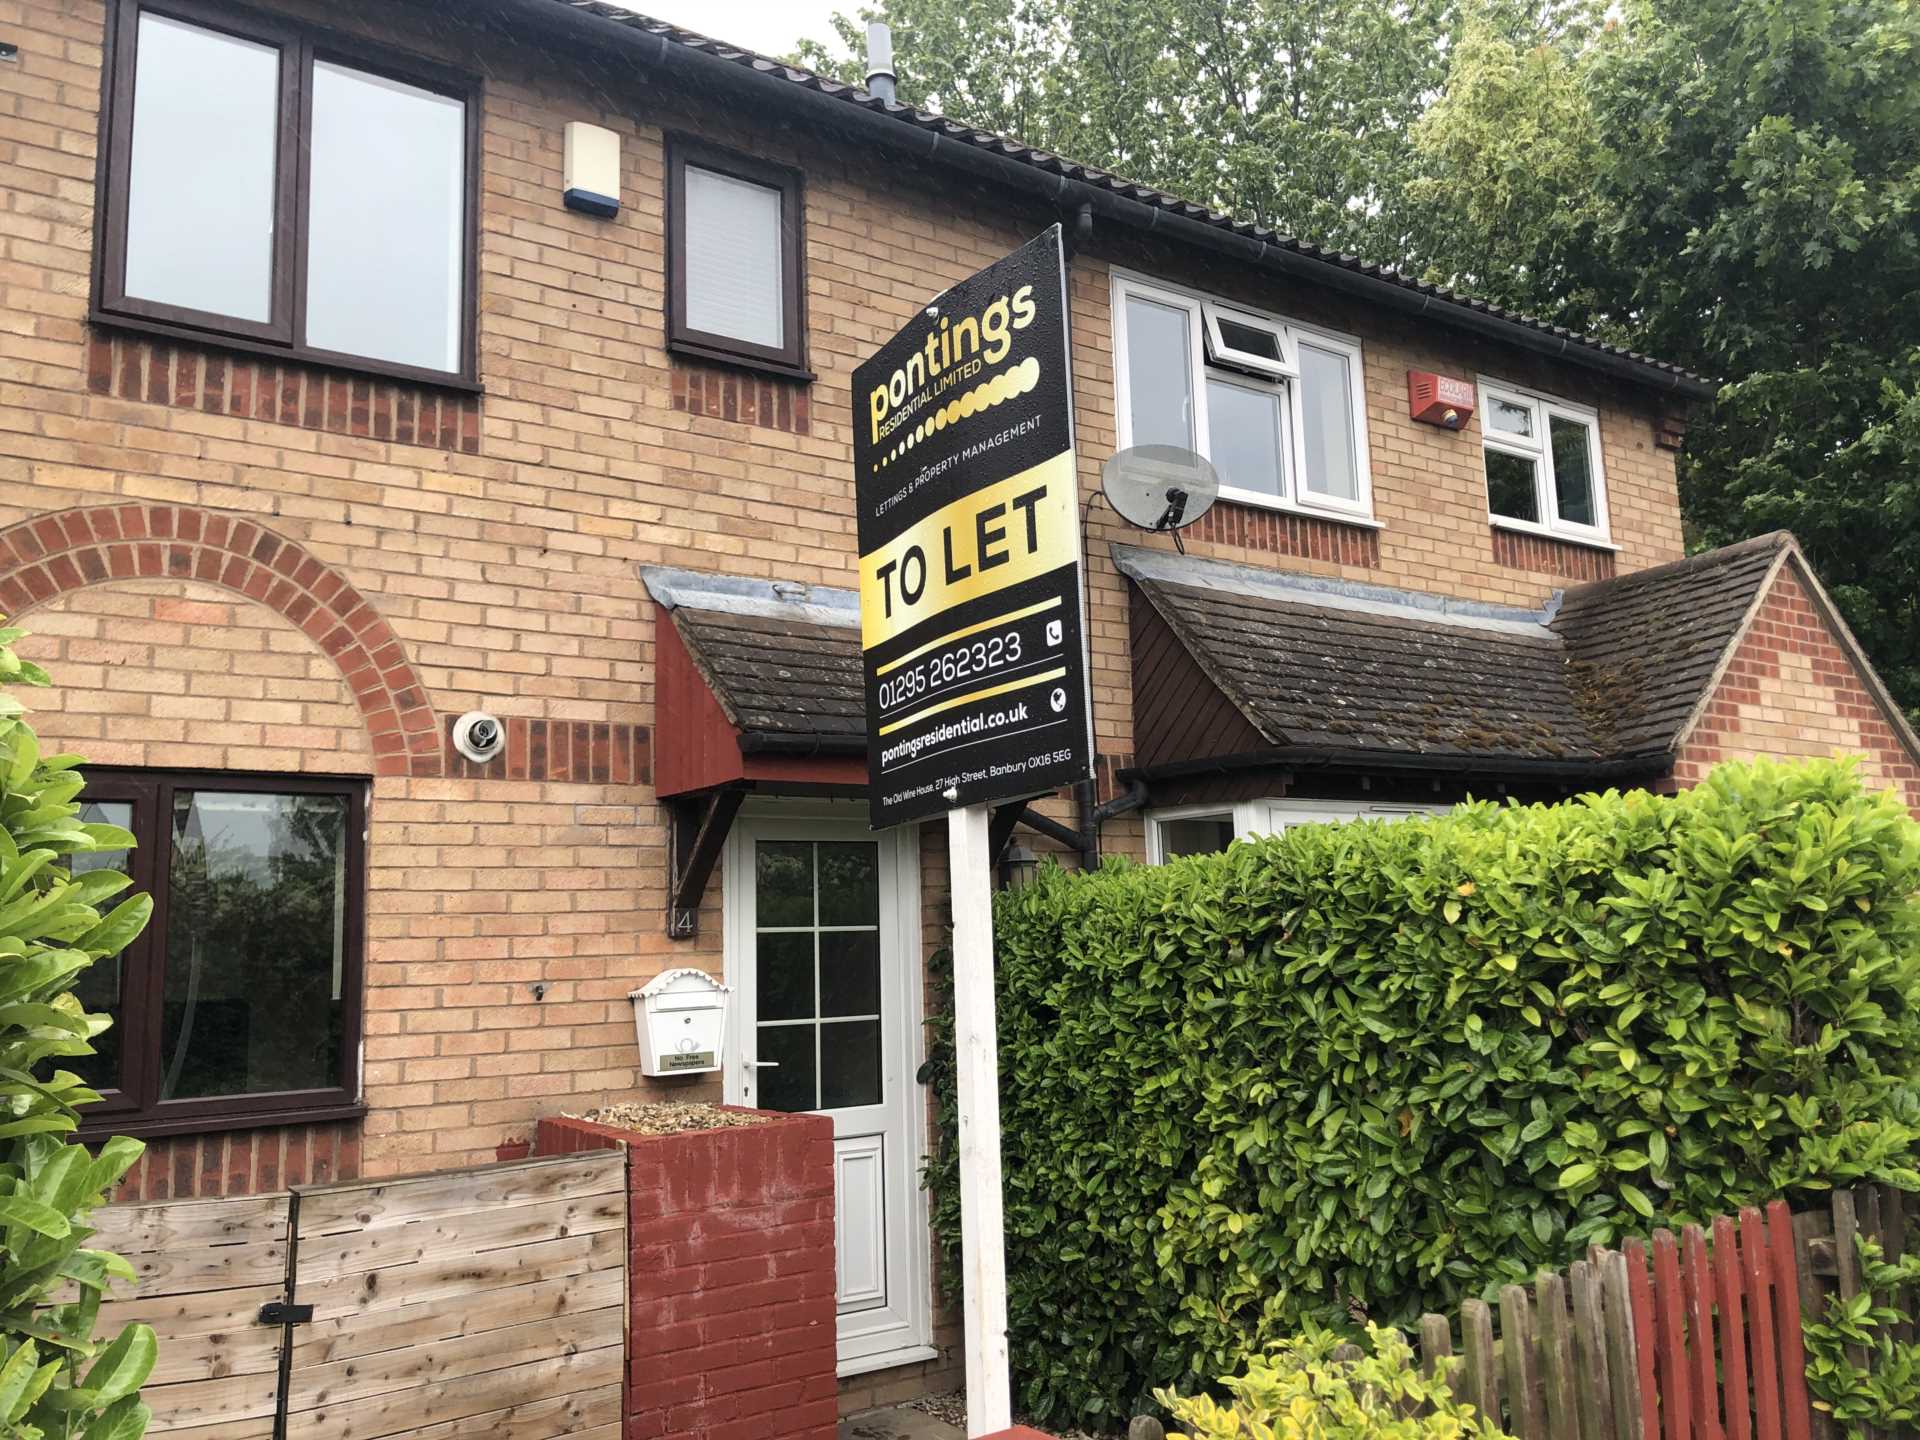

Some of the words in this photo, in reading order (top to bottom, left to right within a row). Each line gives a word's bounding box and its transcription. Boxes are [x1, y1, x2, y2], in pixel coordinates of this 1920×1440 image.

[870, 285, 1036, 445] pontings
[879, 387, 932, 440] RESIDENTIAL
[934, 358, 982, 396] LIMITED
[875, 486, 907, 517] LETTINGS
[908, 482, 914, 493] &
[914, 453, 960, 489] PROPERTY
[962, 414, 1042, 461] MANAGEMENT
[876, 544, 927, 619] TO
[943, 485, 1047, 586] LET
[879, 664, 926, 709] 01295
[929, 632, 1022, 688] 262323
[881, 702, 1029, 767] pontingsresidential.co.uk
[882, 796, 892, 807] The
[893, 792, 902, 804] Old
[902, 789, 916, 802] Wine
[916, 785, 934, 797] House,
[935, 778, 944, 790] 27
[944, 774, 960, 788] High
[961, 769, 988, 783] Street,
[989, 759, 1026, 777] Banbury
[1028, 752, 1051, 769] OX16
[1052, 748, 1072, 763] 5EG
[678, 911, 693, 932] 4
